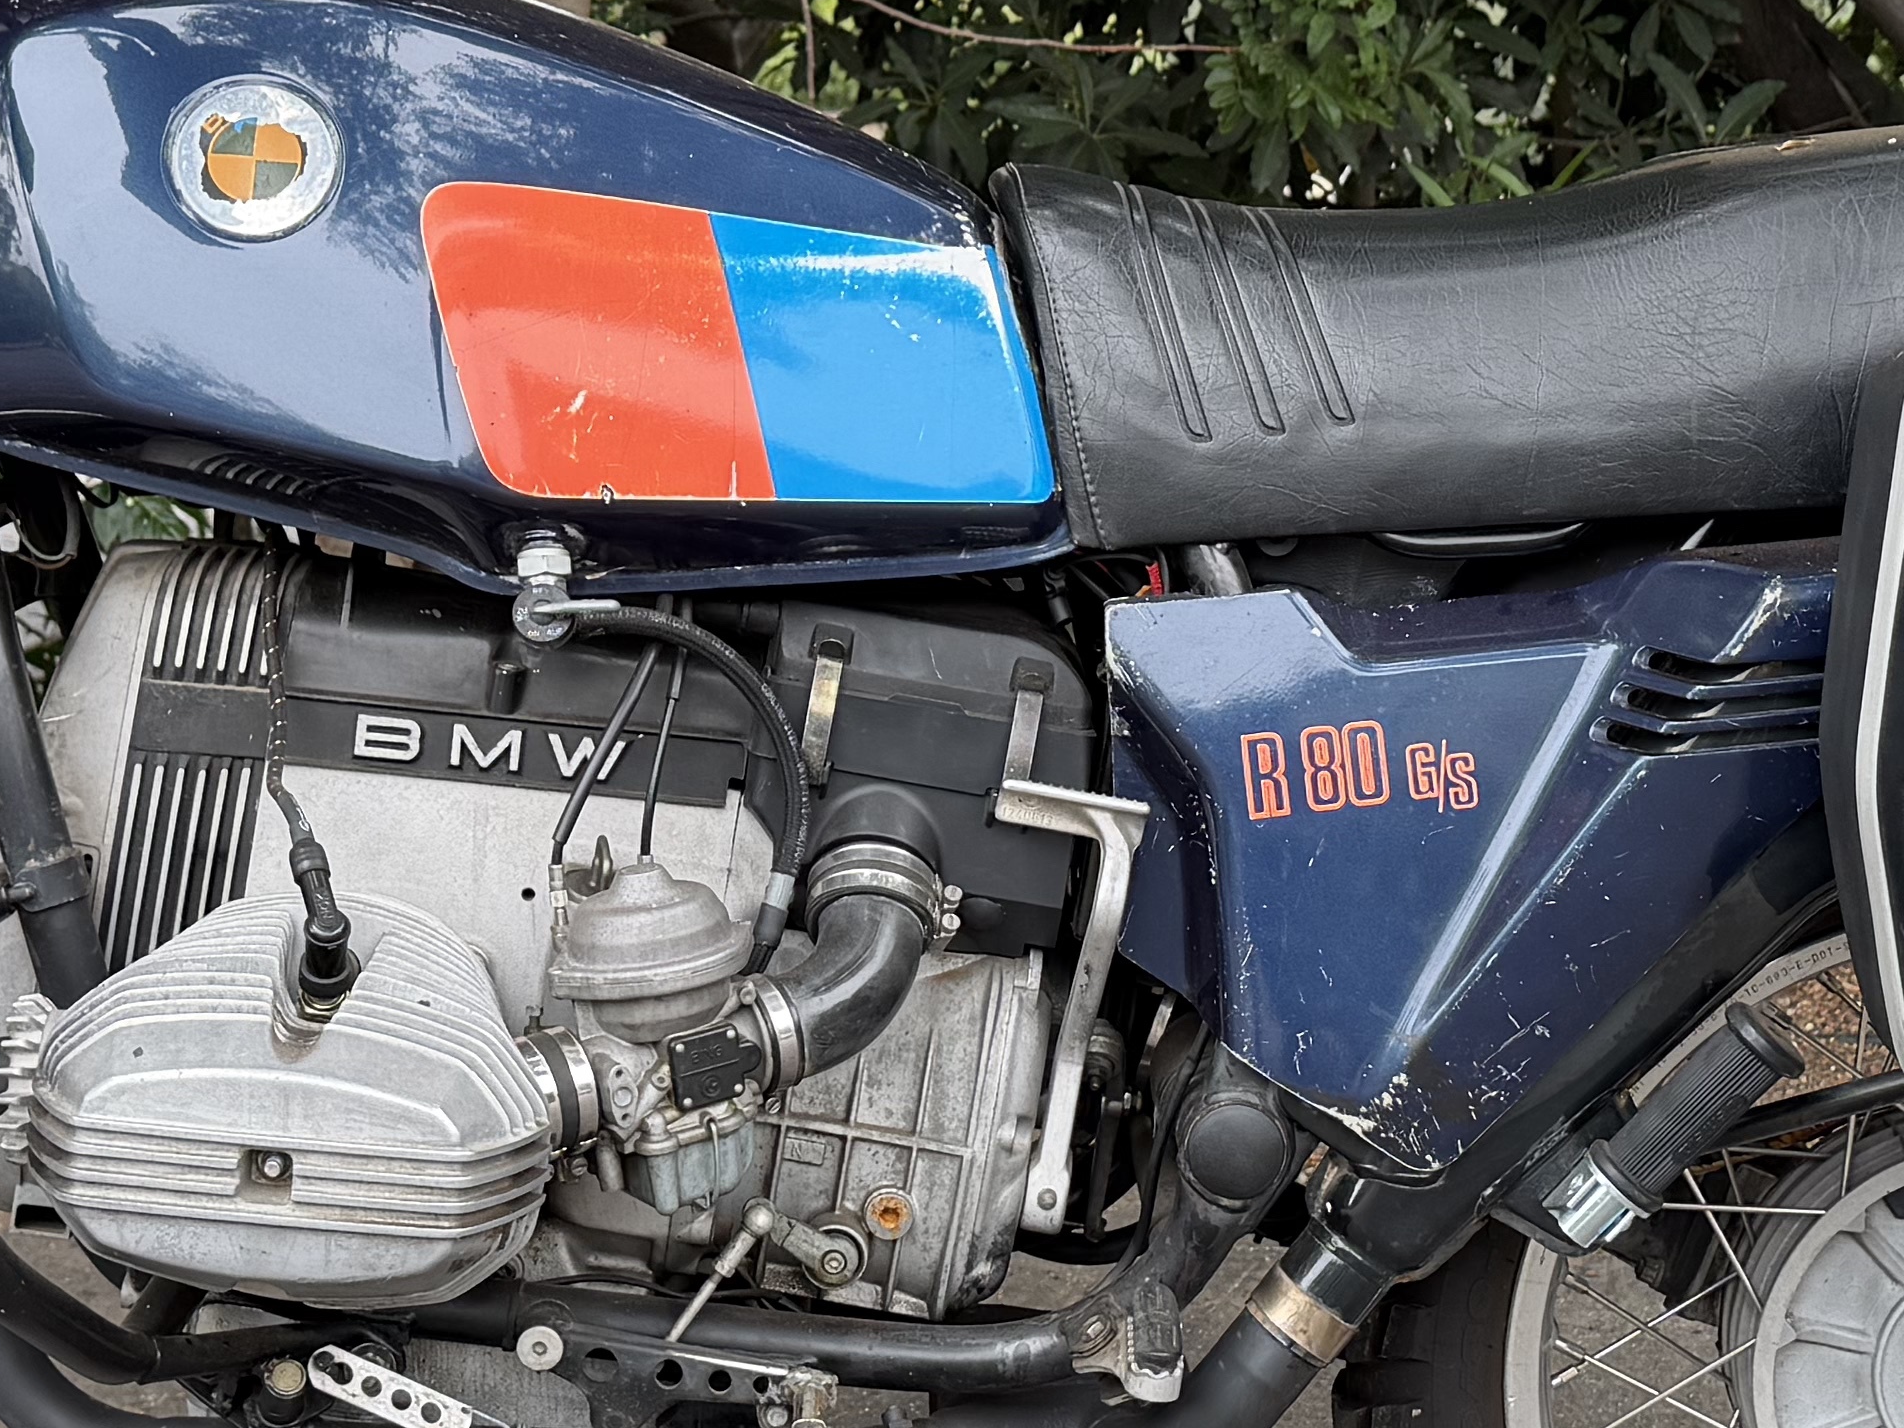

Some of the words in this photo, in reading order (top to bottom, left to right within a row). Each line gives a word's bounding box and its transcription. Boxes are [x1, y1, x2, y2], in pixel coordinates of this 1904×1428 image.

[352, 713, 630, 782] BMW
[1240, 731, 1292, 820] R
[1301, 719, 1390, 813] 80
[1406, 738, 1479, 814] G/S
